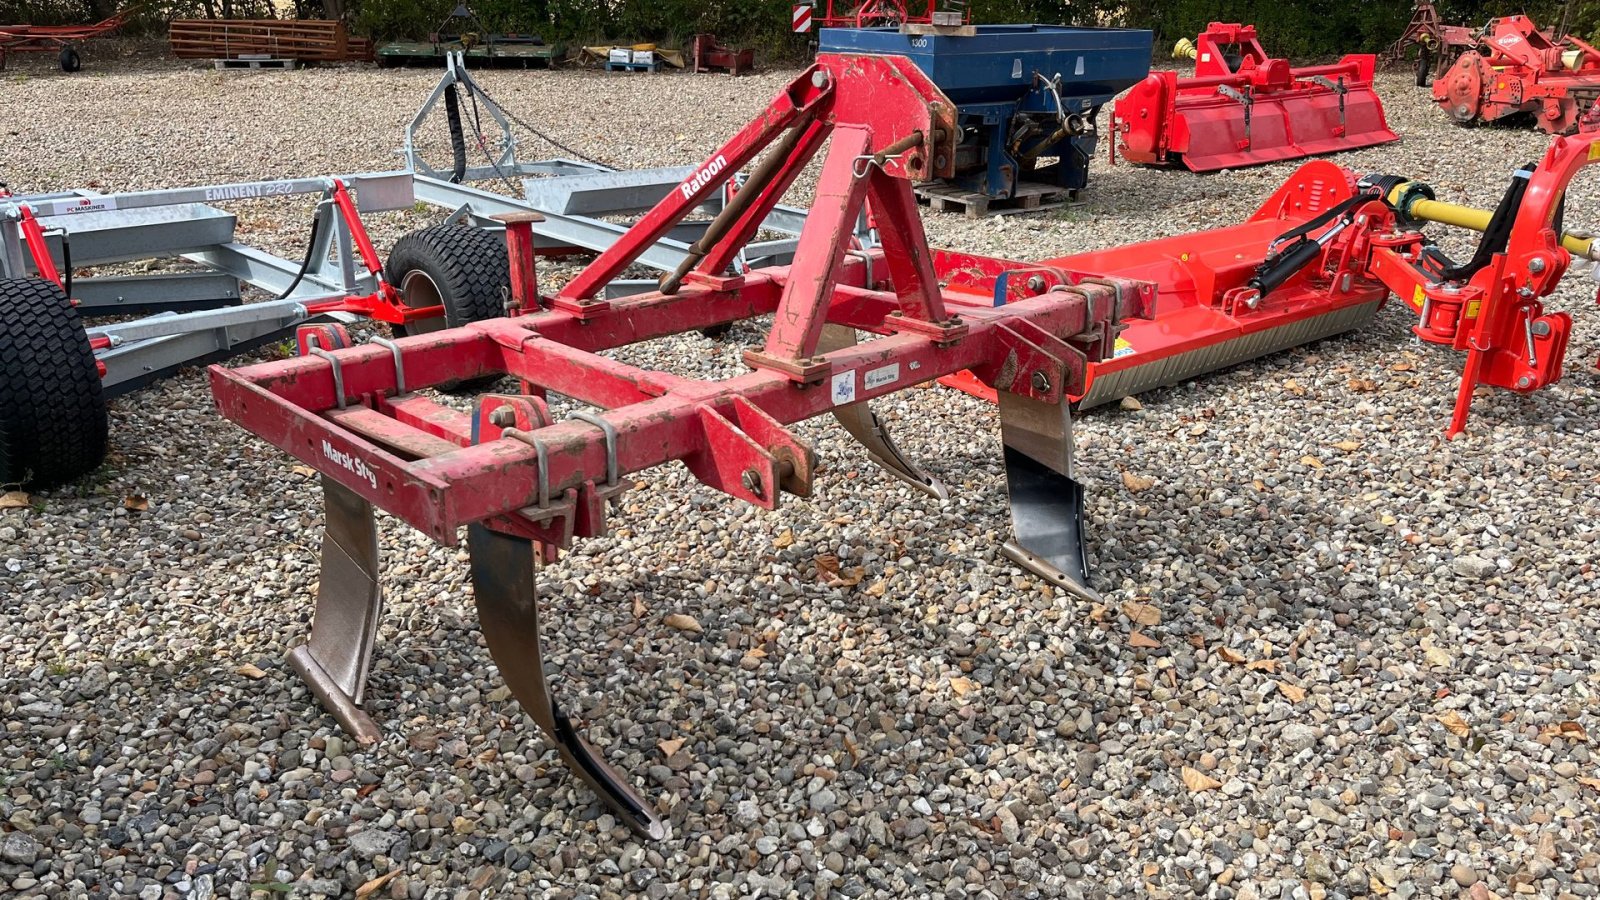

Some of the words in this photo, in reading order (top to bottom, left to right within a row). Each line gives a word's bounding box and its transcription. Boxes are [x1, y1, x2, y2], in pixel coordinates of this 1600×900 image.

[911, 38, 928, 48] 1300
[680, 154, 728, 200] Ratoon
[205, 185, 262, 201] EMINENT
[265, 182, 294, 196] PRO
[321, 439, 356, 473] Marsk
